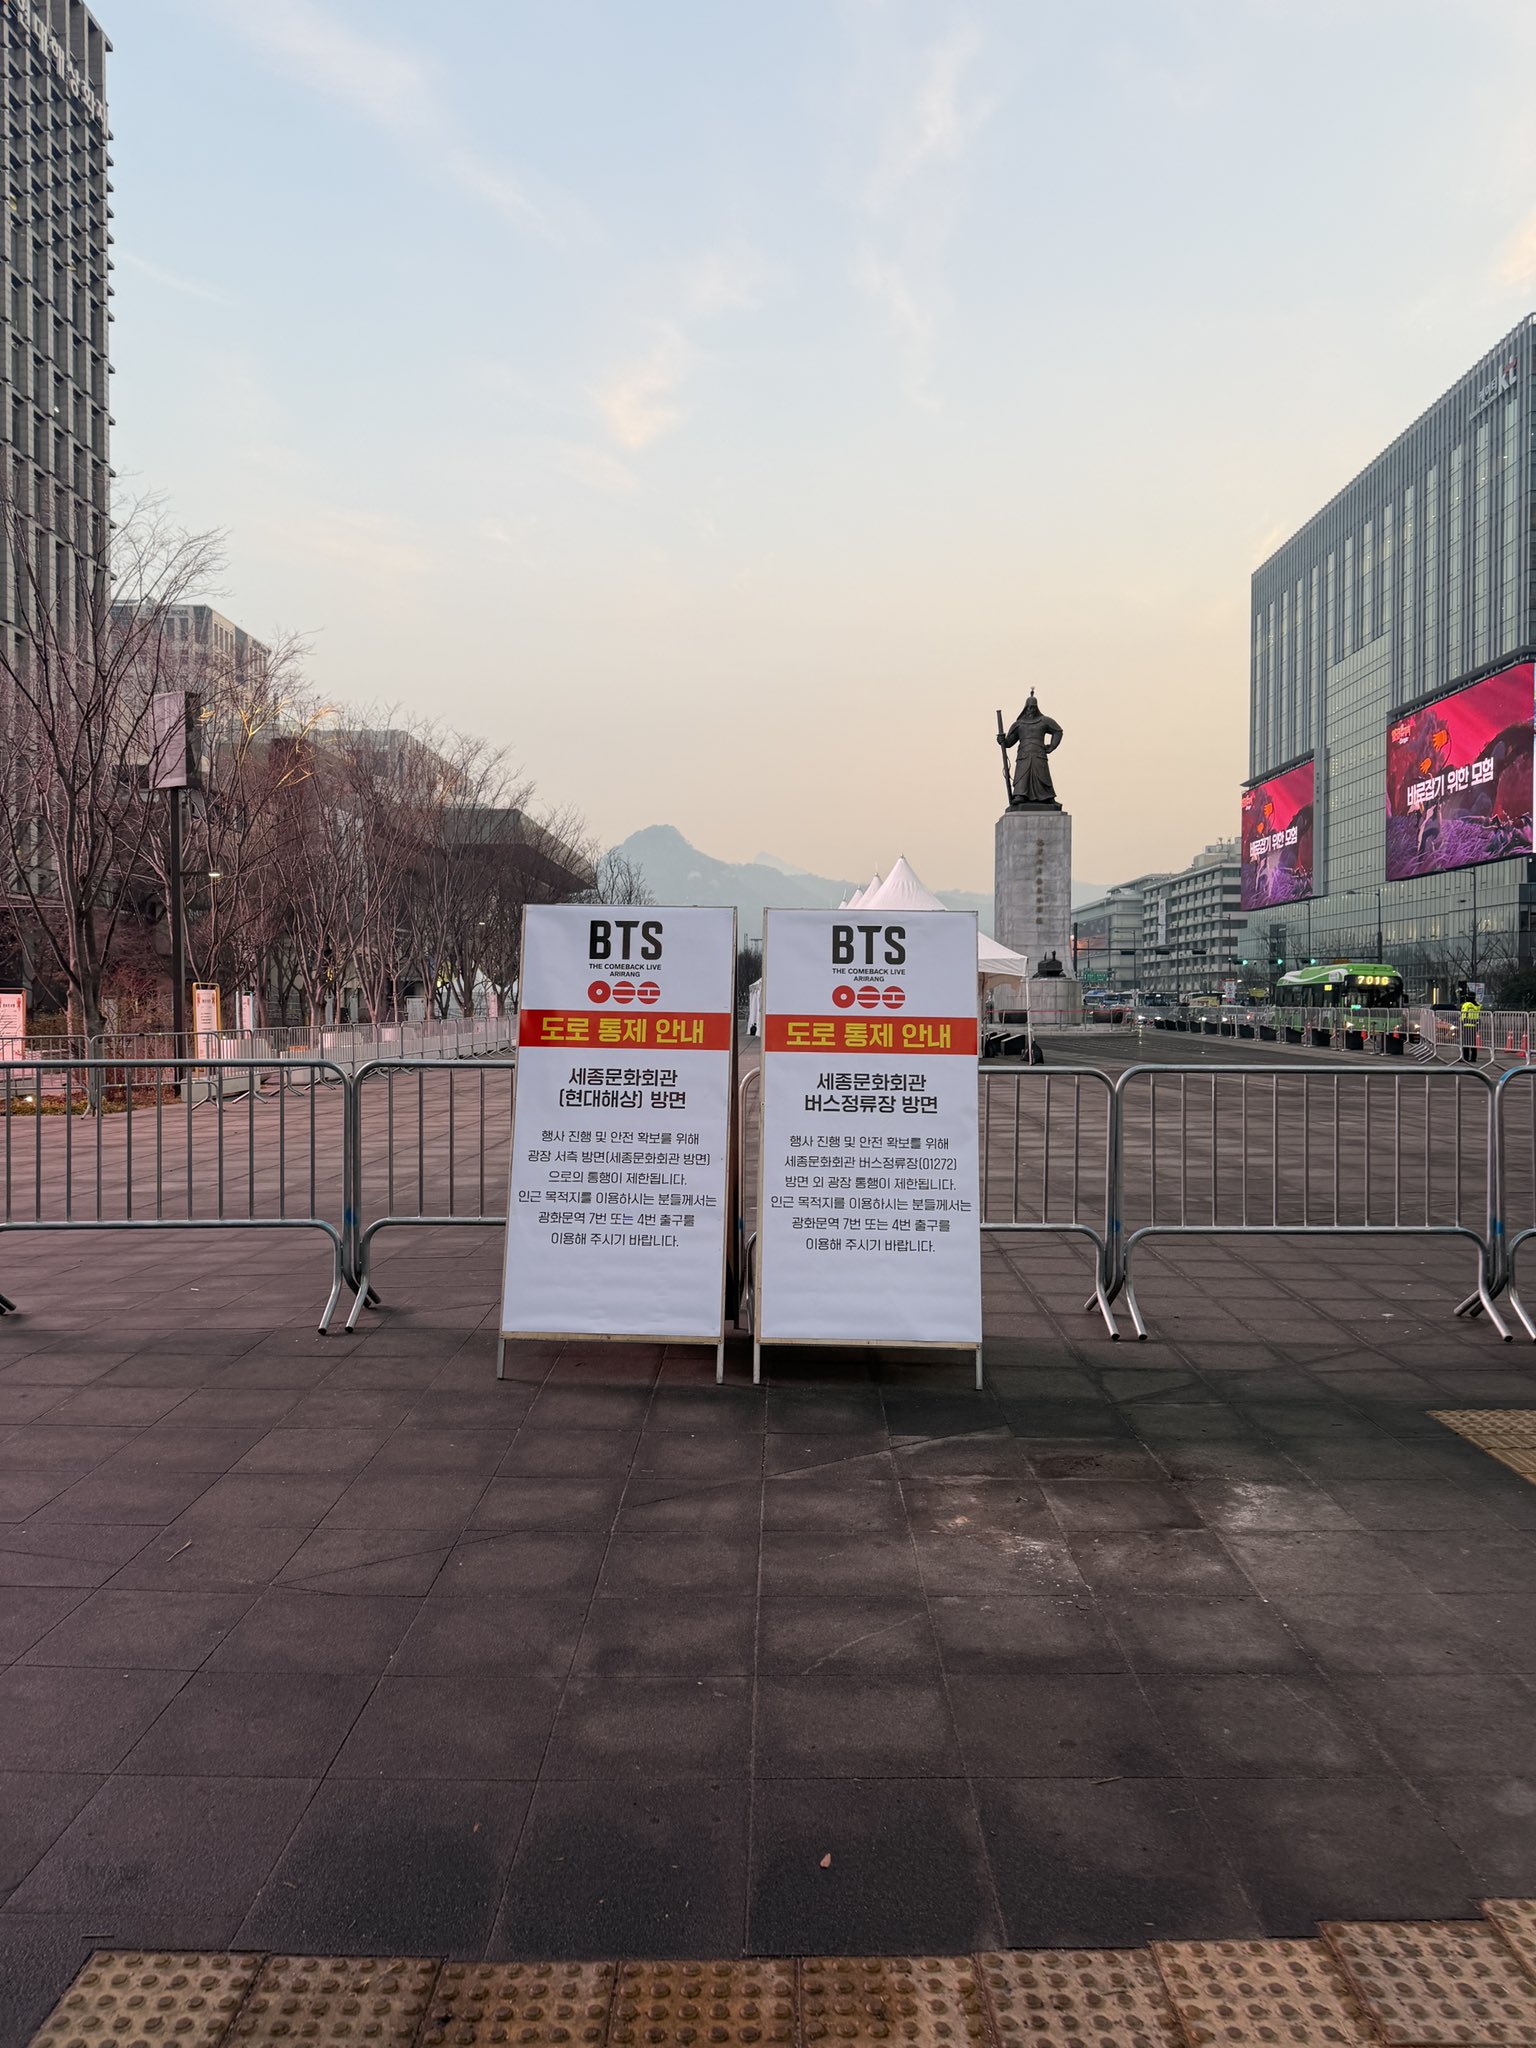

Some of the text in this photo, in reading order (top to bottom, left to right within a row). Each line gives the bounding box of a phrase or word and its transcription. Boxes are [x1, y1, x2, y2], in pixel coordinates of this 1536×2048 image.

[1447, 769, 1468, 793] 위한
[1471, 757, 1493, 786] 모험
[589, 920, 663, 960] BTS
[832, 925, 906, 965] BTS
[541, 1018, 703, 1043] 도로 통제 안내
[787, 1023, 950, 1048] 도로 통제 안내
[569, 1068, 678, 1087] 세종문화회관
[817, 1073, 927, 1092] 세종문화회관
[651, 1091, 686, 1109] 방면
[805, 1094, 938, 1114] 버스정류장 방면
[542, 1130, 699, 1145] 행사 진행 및 안전 확보를 위해
[790, 1135, 948, 1150] 행사 진행 및 안전 확보를 위해
[528, 1150, 551, 1162] 광장
[555, 1151, 578, 1163] 서측
[684, 1153, 710, 1166] 방면)
[784, 1156, 957, 1170] 세종문화회관 버스정류장(01272)
[548, 1171, 687, 1185] 으로의 통행이 제한됩니다.
[785, 1176, 956, 1190] 방면 외 광장 통행이 제한됩니다.
[519, 1190, 717, 1207] 인근 목적지를 이용하시는 분들께서는
[771, 1196, 972, 1212] 인근 목적지를 이용하시는 분들께서는
[538, 1211, 694, 1227] 광화문역 7번 또는 4번 출구를
[792, 1217, 950, 1232] 광화문역 7번 또는 4번 출구를
[551, 1232, 679, 1247] 이용해 주시기 바랍니다.
[806, 1238, 935, 1252] 이용해 주시기 바랍니다.
